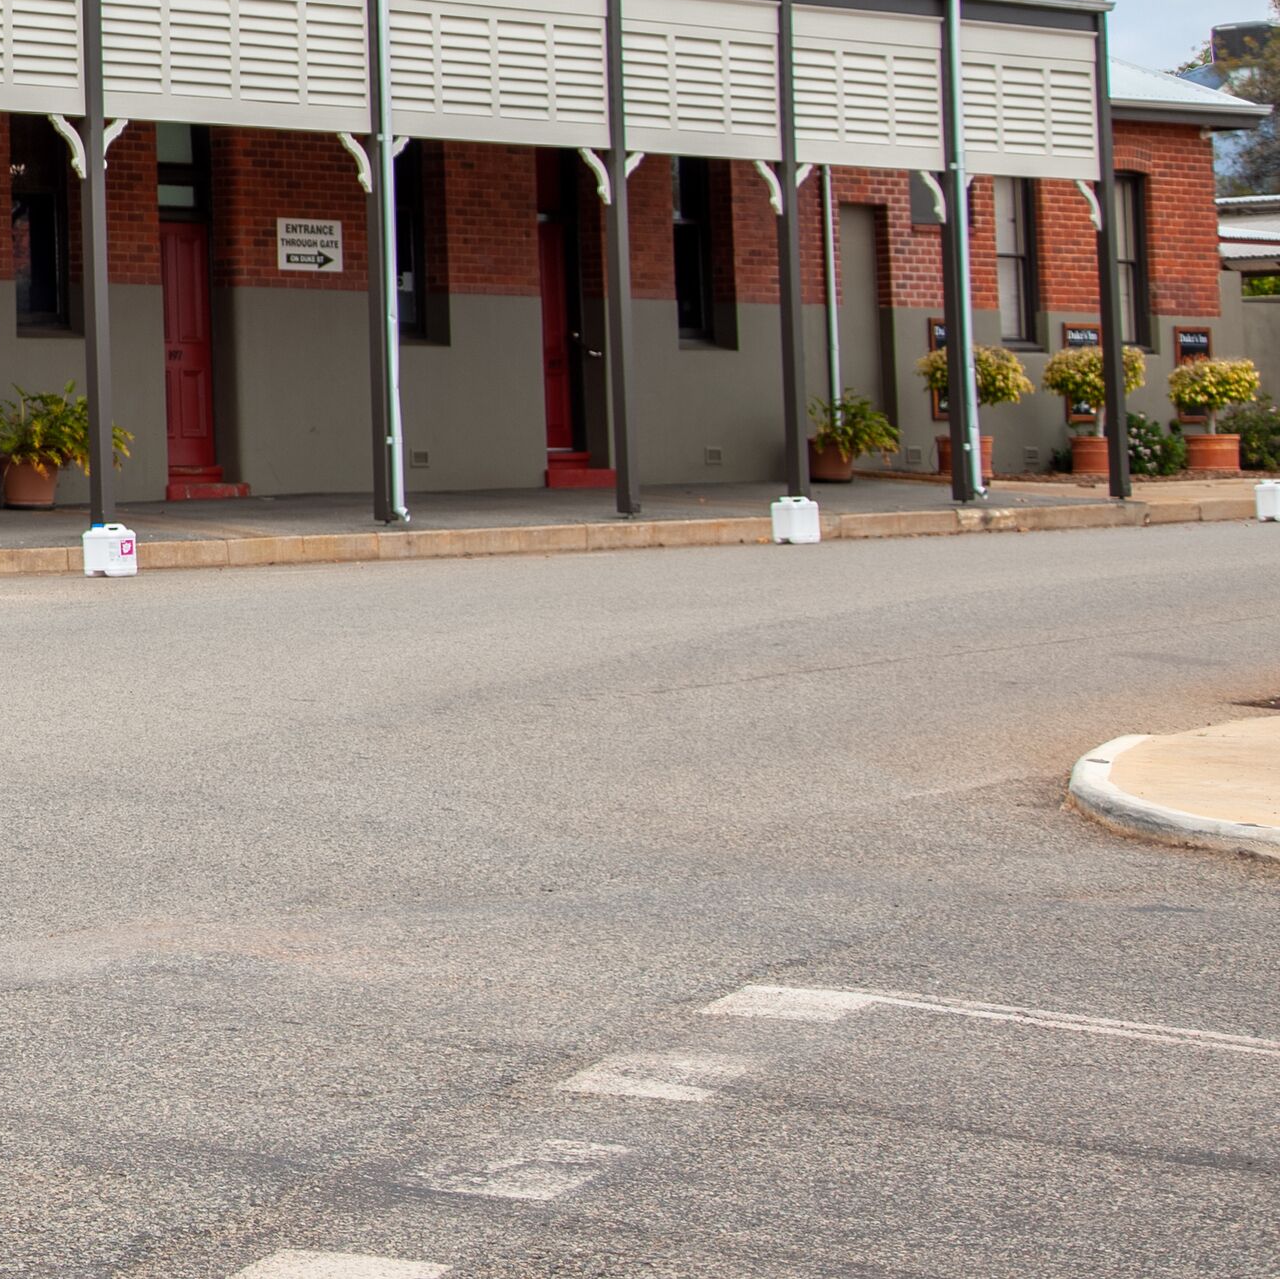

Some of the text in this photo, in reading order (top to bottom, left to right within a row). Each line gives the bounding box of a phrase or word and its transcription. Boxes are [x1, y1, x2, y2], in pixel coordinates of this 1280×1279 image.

[285, 223, 334, 236] ENTRANCE
[281, 238, 339, 249] THROUGH GATE
